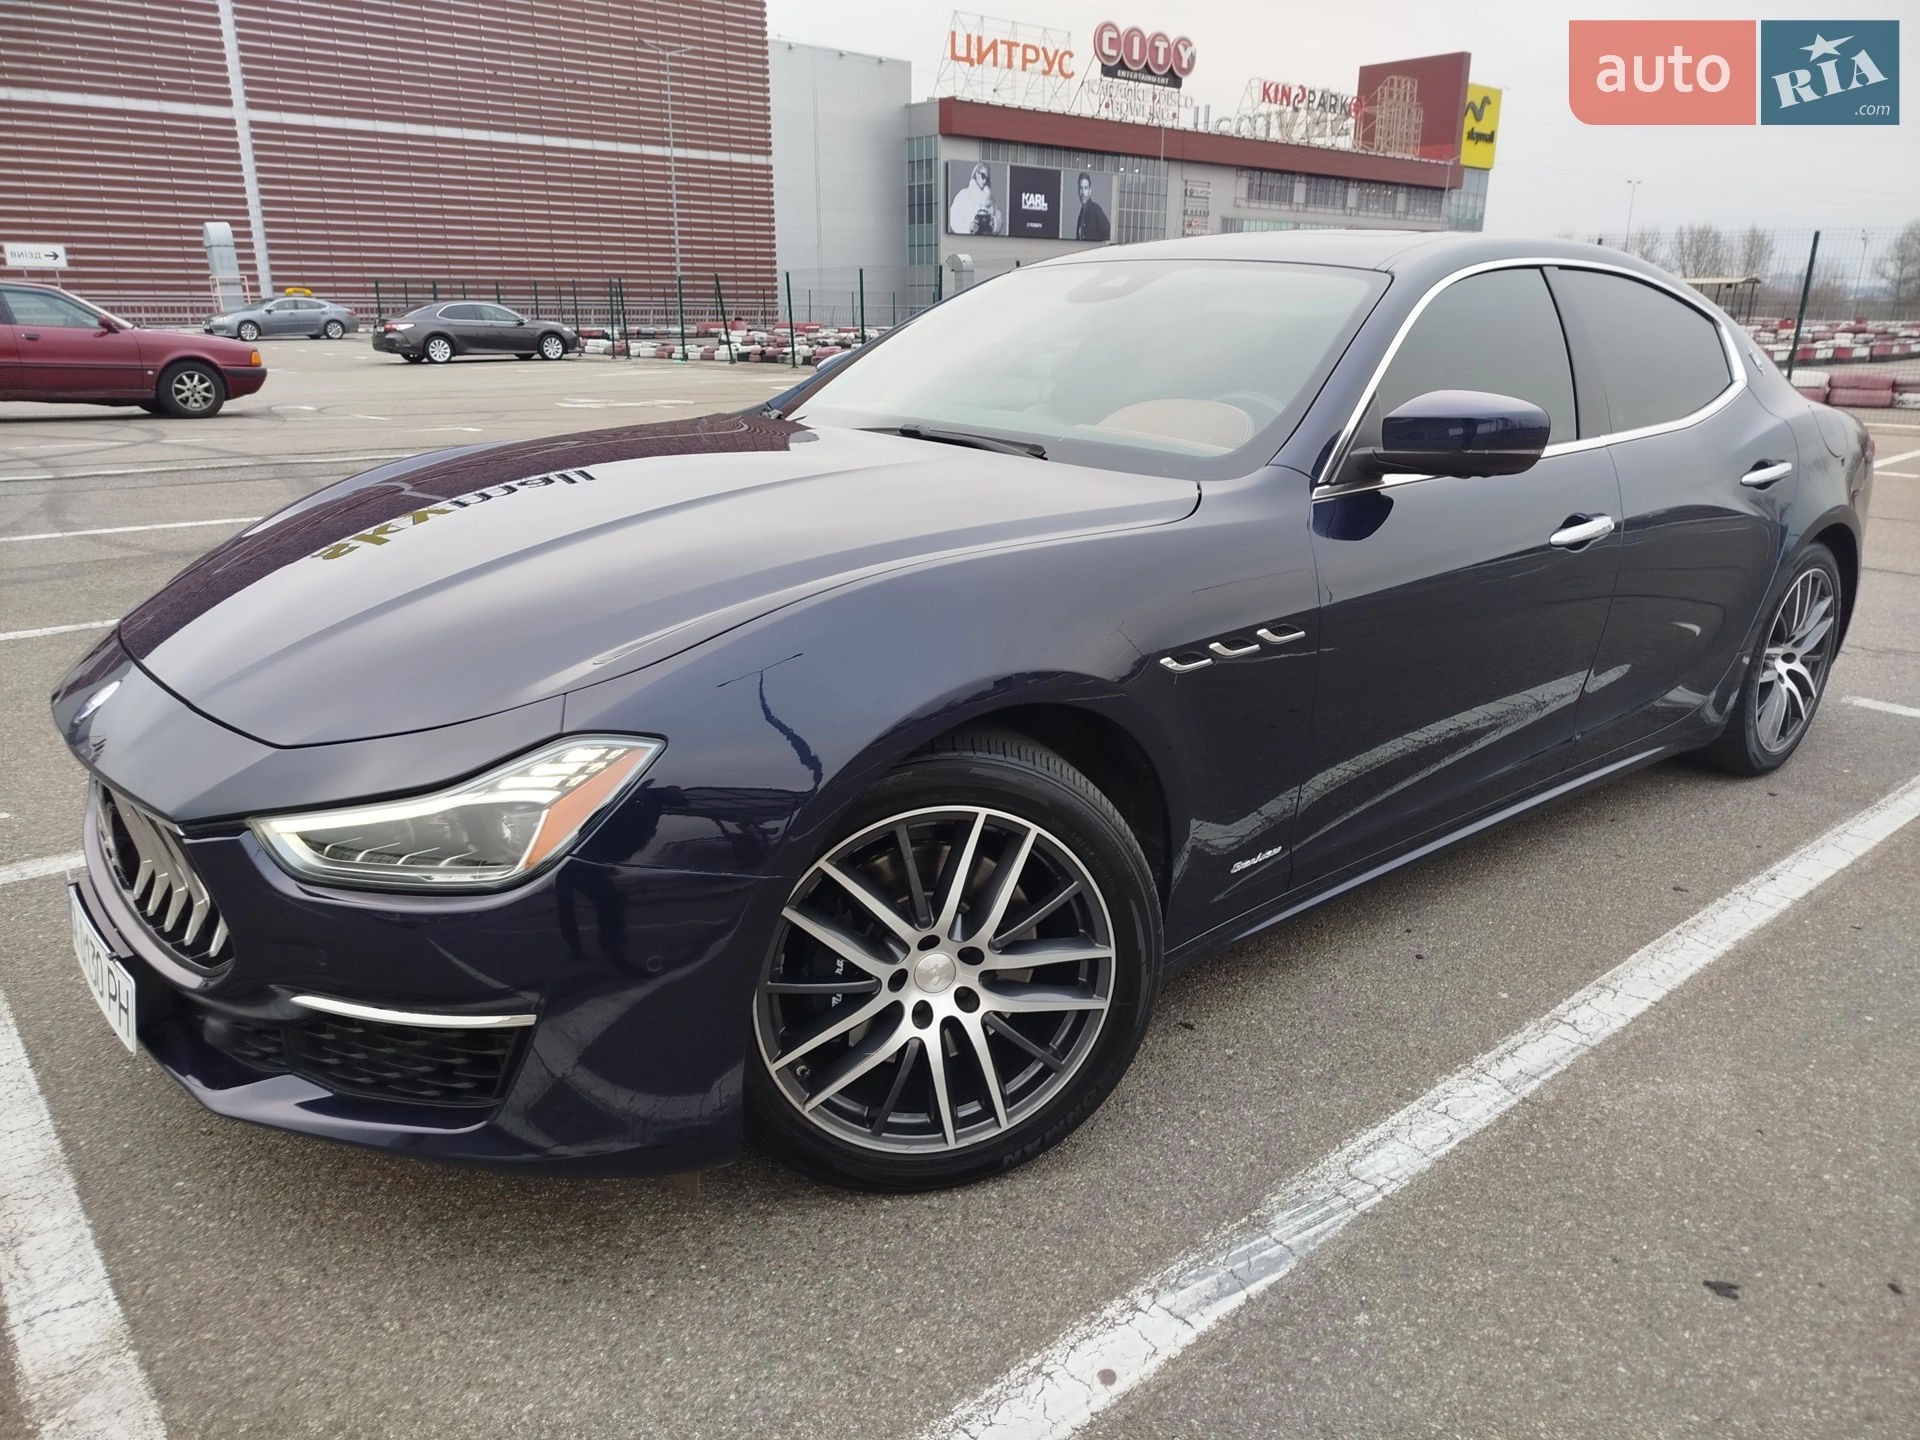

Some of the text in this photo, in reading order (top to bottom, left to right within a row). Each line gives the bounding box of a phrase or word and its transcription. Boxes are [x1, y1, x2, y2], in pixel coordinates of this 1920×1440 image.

[950, 30, 1075, 79] ЦИТРУС
[1101, 30, 1196, 69] CITY
[1117, 69, 1169, 85] ENTERTAINMENT
[1021, 192, 1048, 206] KARL
